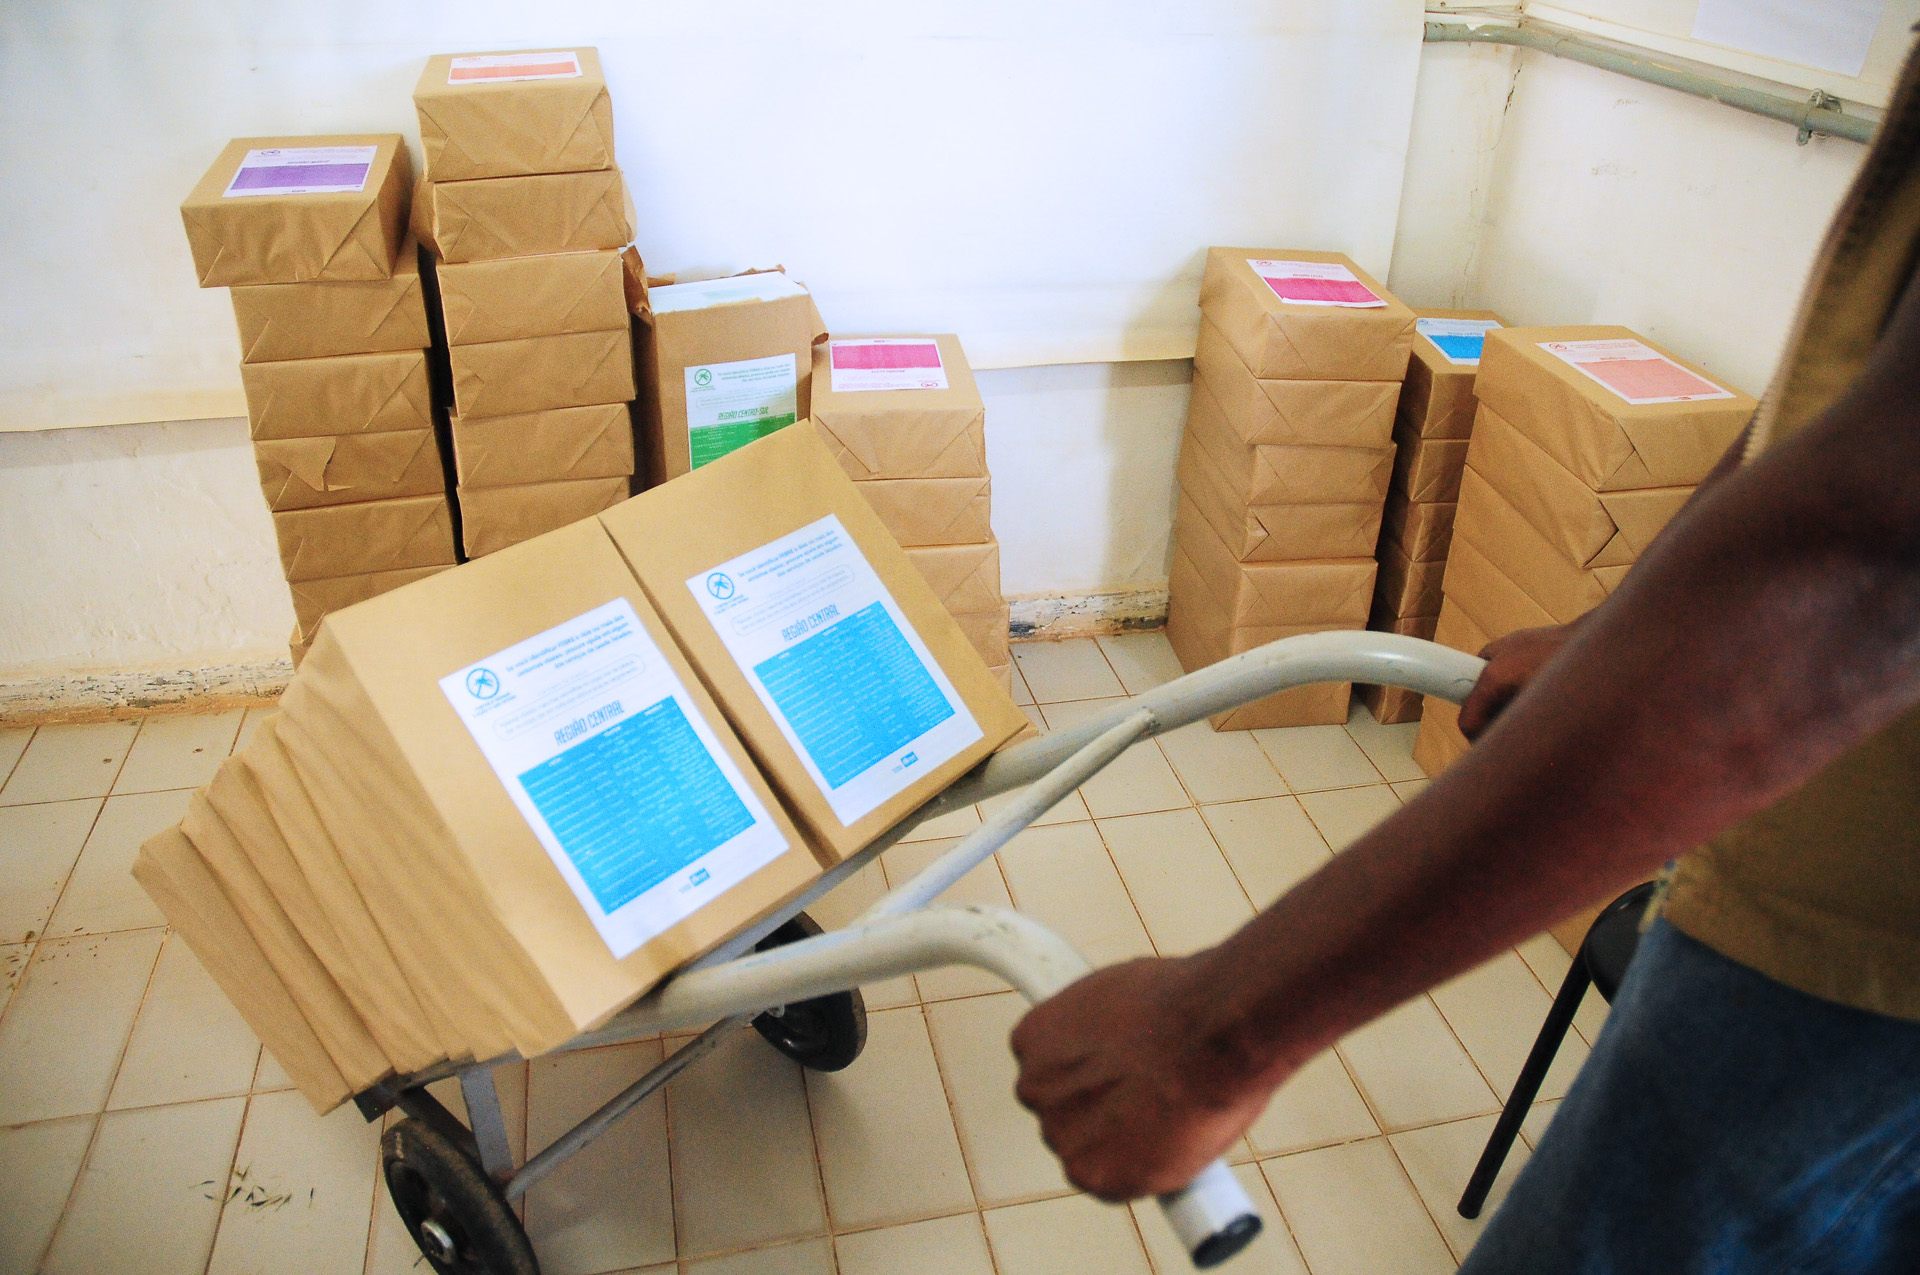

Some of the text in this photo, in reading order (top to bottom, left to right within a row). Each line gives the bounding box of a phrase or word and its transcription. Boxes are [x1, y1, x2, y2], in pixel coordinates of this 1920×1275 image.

[781, 619, 809, 642] REGIÃO
[808, 603, 840, 629] CENTRAL
[554, 715, 587, 747] REGIÃO
[586, 699, 625, 728] CENTRAL
